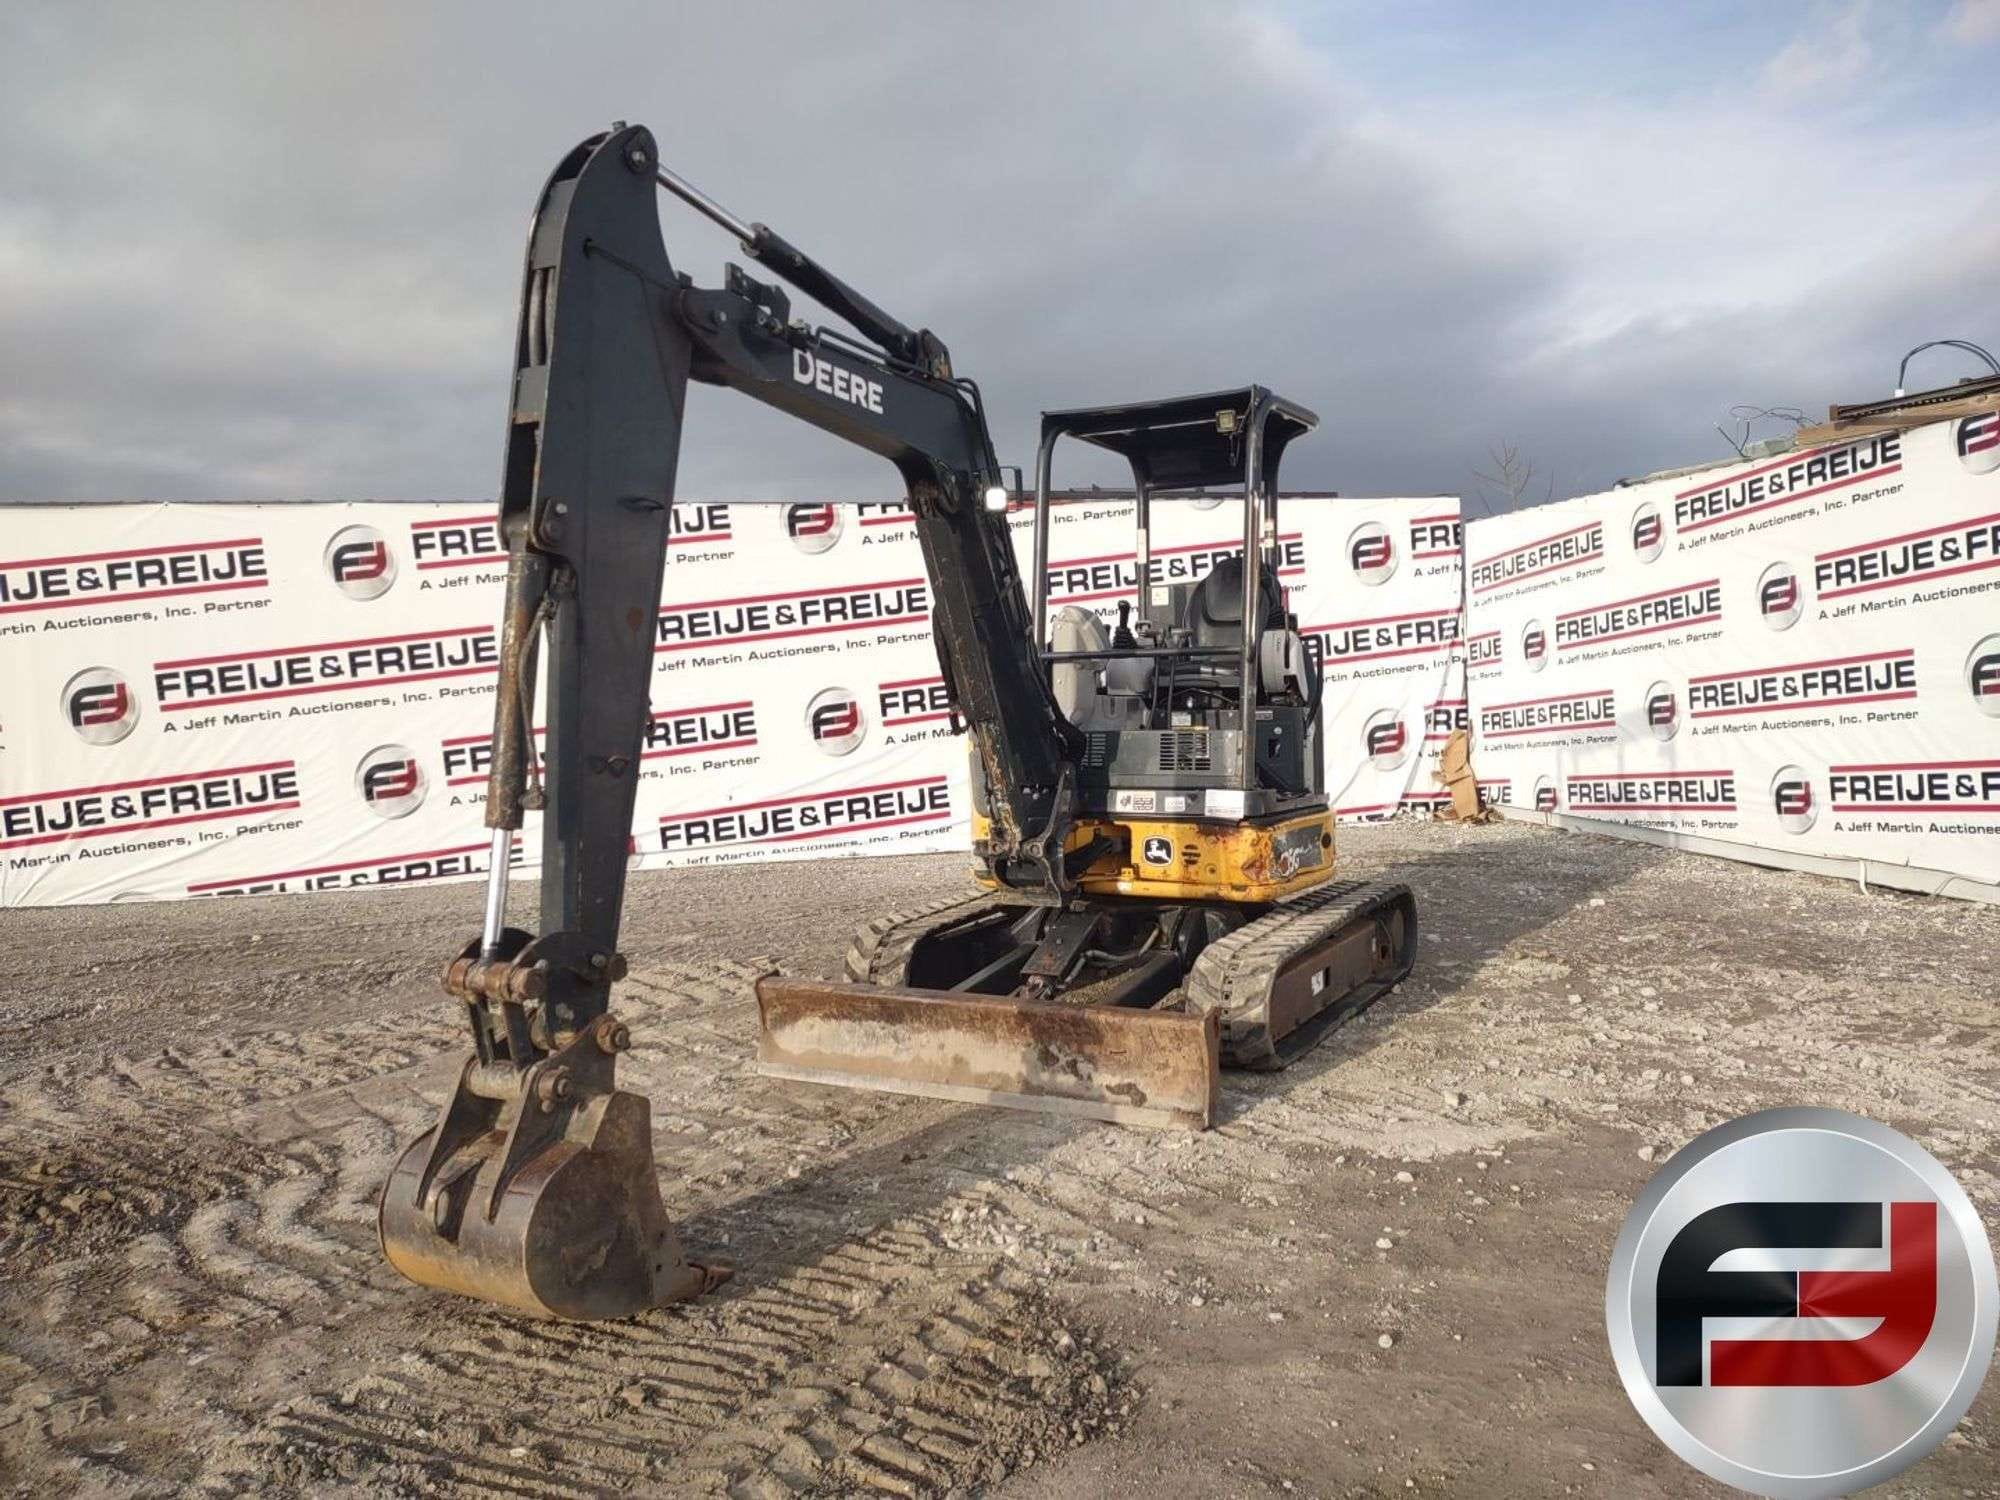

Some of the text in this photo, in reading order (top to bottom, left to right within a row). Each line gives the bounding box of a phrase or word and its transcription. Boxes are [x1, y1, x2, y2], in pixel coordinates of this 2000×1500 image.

[793, 348, 883, 415] DEERE
[672, 504, 731, 534] IJE
[1054, 507, 1135, 524] Inc. Partner
[1678, 483, 1904, 551] A Jeff Martin Auctioneers, Inc. Partner
[411, 526, 496, 560] FRE
[862, 535, 873, 545] A
[877, 531, 904, 543] Jeff
[676, 551, 734, 564] Partner
[419, 573, 508, 590] A Jeff Mar
[0, 598, 272, 636] rtin Auctioneers, Inc. Partner
[1818, 609, 1829, 620] A
[1832, 604, 1856, 618] Jeff
[1860, 596, 1906, 613] Martin
[657, 631, 931, 672] Jeff Martin Auctioneers, Inc. Partner
[1469, 638, 1502, 661] EIJE
[1324, 673, 1347, 683] rtin
[163, 721, 177, 733] A
[183, 716, 217, 730] Jeff
[223, 709, 281, 725] Martin
[288, 697, 396, 717] Auctioneers,
[402, 693, 432, 703] Inc.
[879, 685, 948, 717] FRE
[646, 710, 757, 749] REIJE
[1691, 711, 1919, 736] A Jeff Martin Auctioneers, Inc. Partner
[885, 735, 896, 745] A
[901, 730, 927, 743] Jeff
[669, 765, 696, 776] Inc.
[702, 756, 760, 771] Partner
[449, 795, 462, 806] A
[1834, 821, 1844, 831] A
[1848, 821, 1872, 832] Jeff
[1876, 821, 1923, 833] Martin
[78, 837, 191, 860] Auctioneers,
[198, 831, 229, 842] Inc.
[236, 820, 303, 837] Partner
